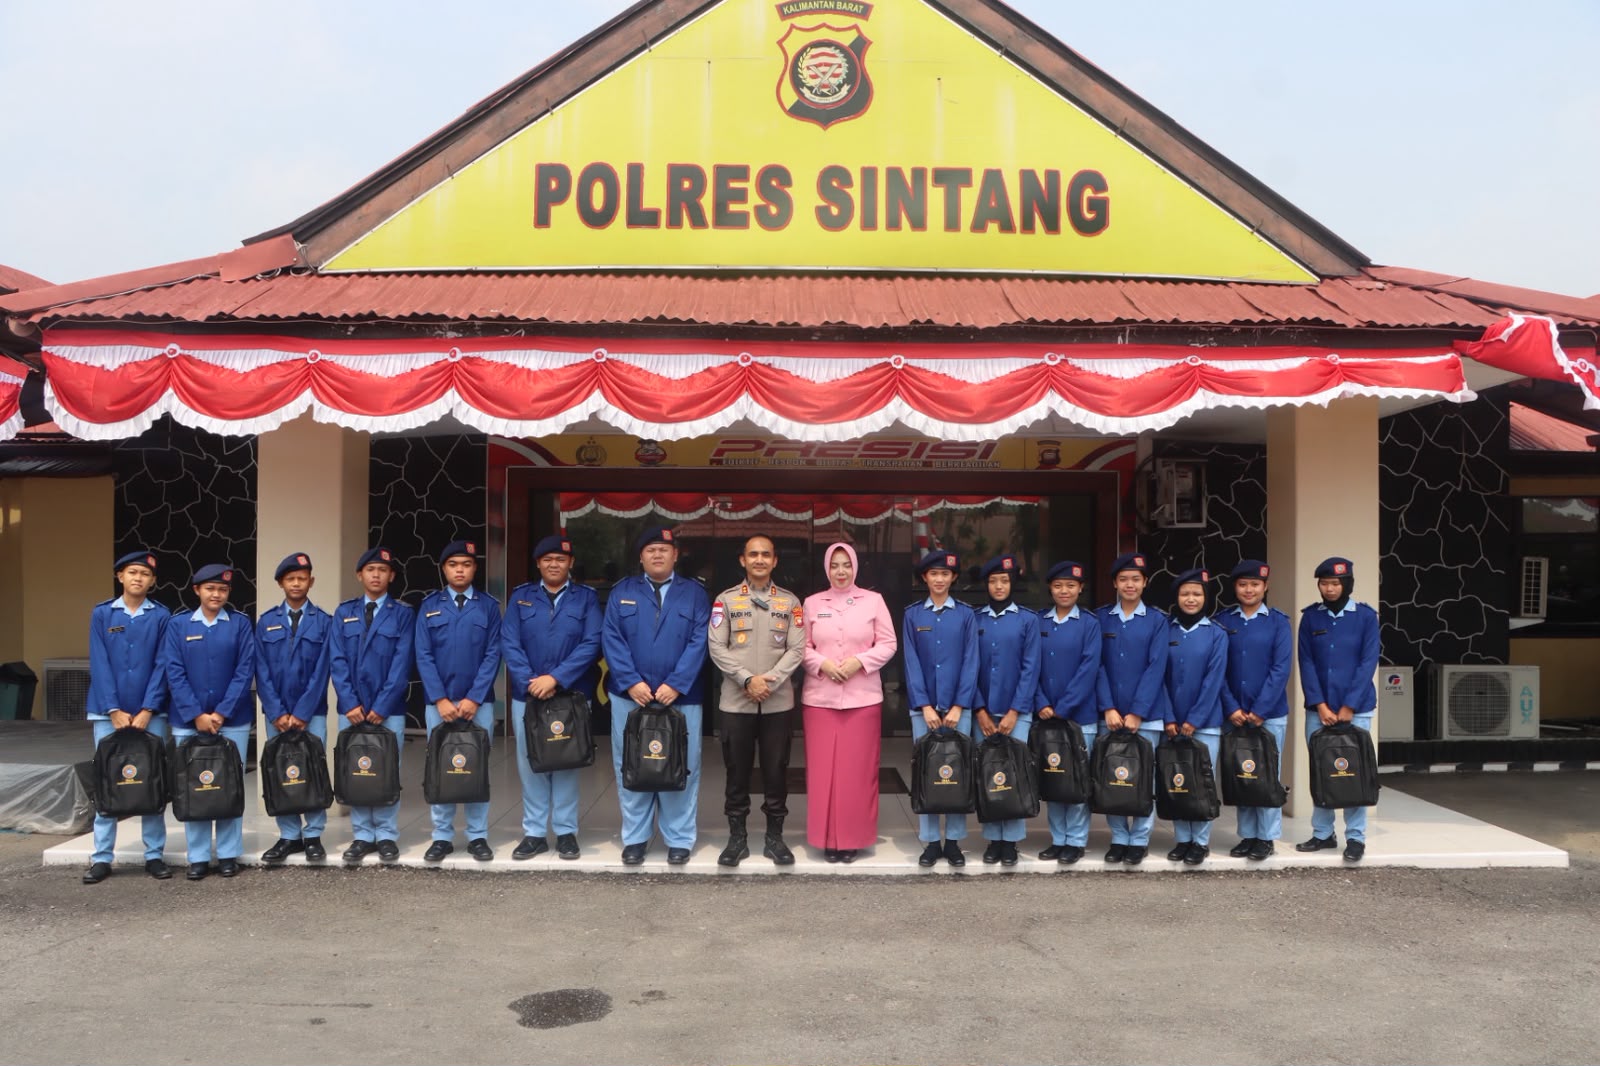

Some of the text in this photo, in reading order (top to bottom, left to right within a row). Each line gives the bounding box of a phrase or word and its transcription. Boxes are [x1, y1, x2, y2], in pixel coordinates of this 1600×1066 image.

[783, 1, 864, 15] KALIMANTAN BARAT
[533, 161, 1110, 237] POLRES SINTANG
[711, 439, 998, 460] PRESISI
[1520, 686, 1533, 724] AUX
